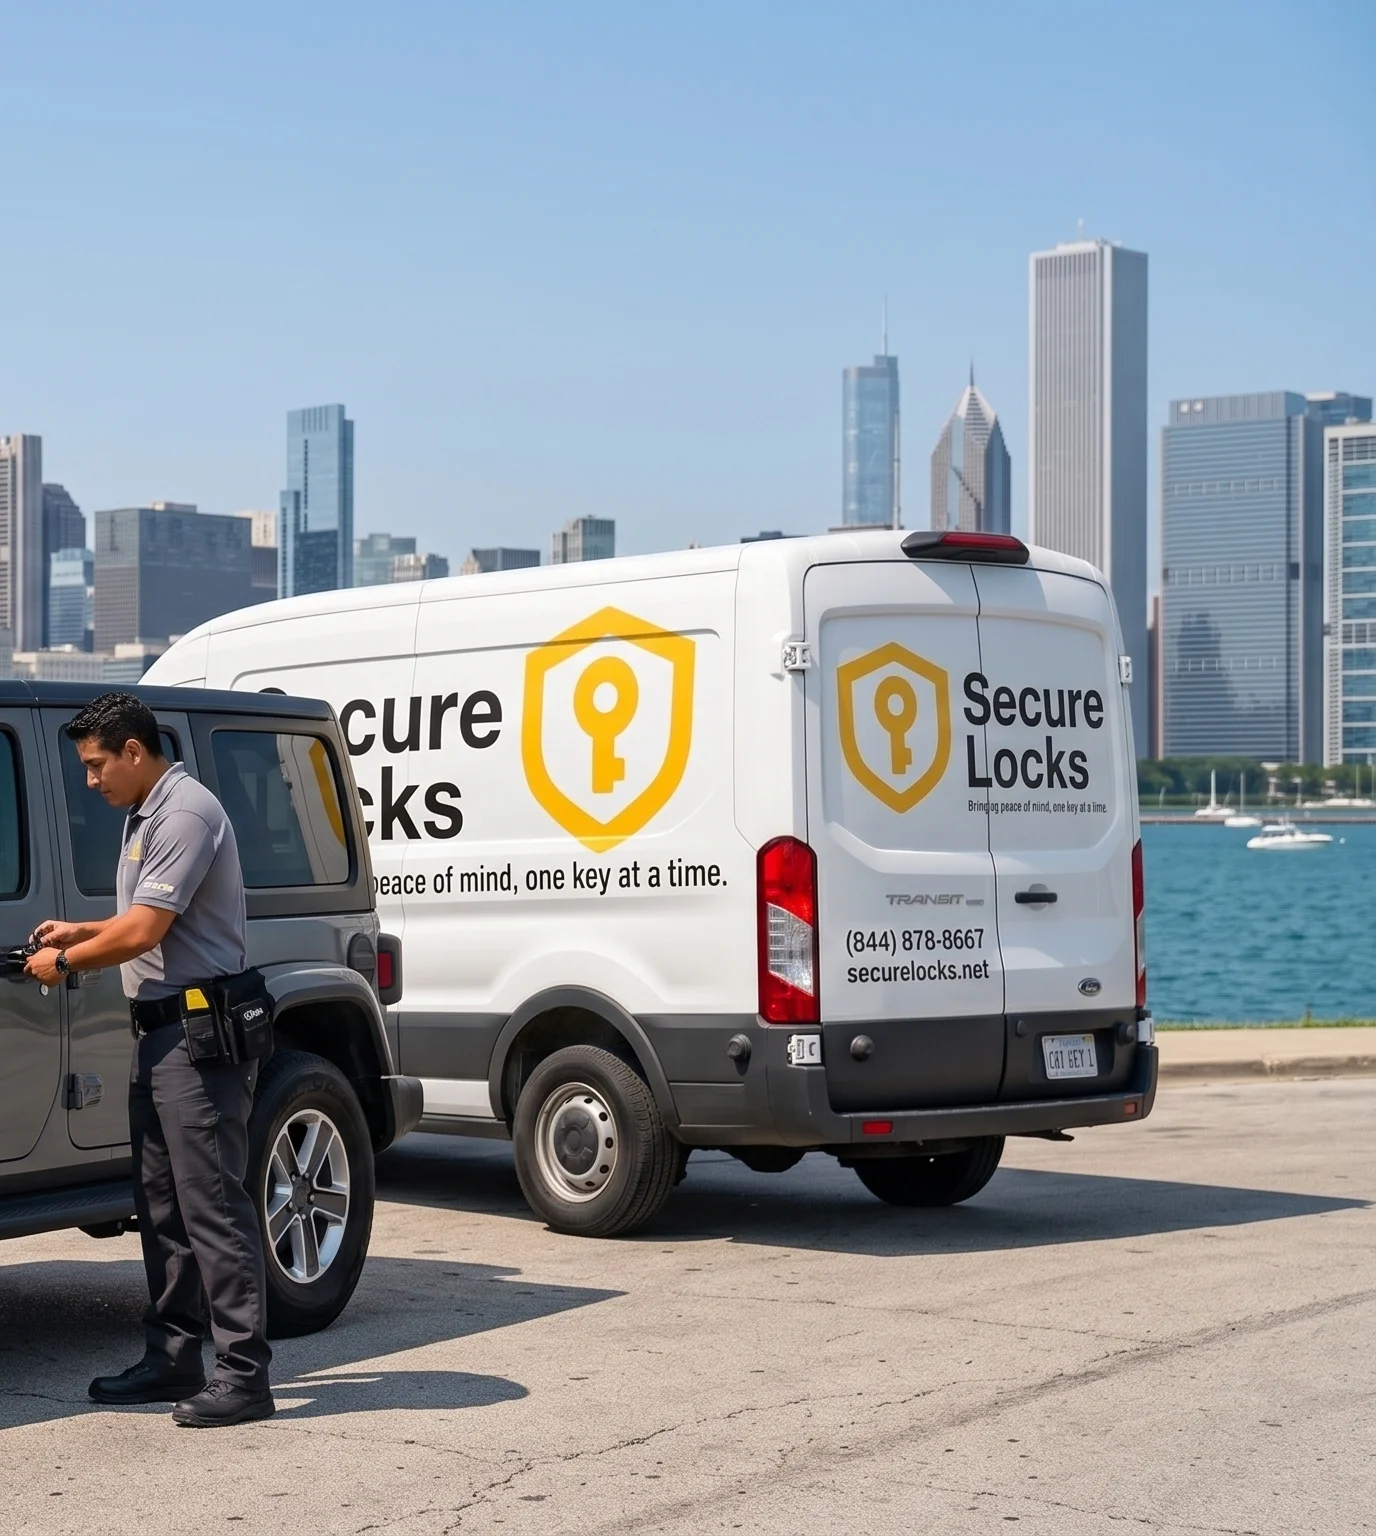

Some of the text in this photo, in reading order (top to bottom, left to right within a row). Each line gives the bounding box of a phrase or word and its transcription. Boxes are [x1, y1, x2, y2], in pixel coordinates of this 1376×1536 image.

[963, 671, 1104, 730] Secure
[258, 687, 503, 756] cure
[966, 734, 1090, 790] Locks
[1000, 802, 1022, 814] peace
[1066, 800, 1079, 815] key
[433, 865, 454, 893] of
[460, 863, 518, 895] mind,
[525, 868, 565, 891] one
[573, 861, 611, 896] key
[618, 860, 641, 888] at
[647, 866, 661, 888] a
[667, 857, 728, 887] time.
[846, 928, 985, 957] (844) 878-8667
[847, 959, 990, 984] securelocks.net
